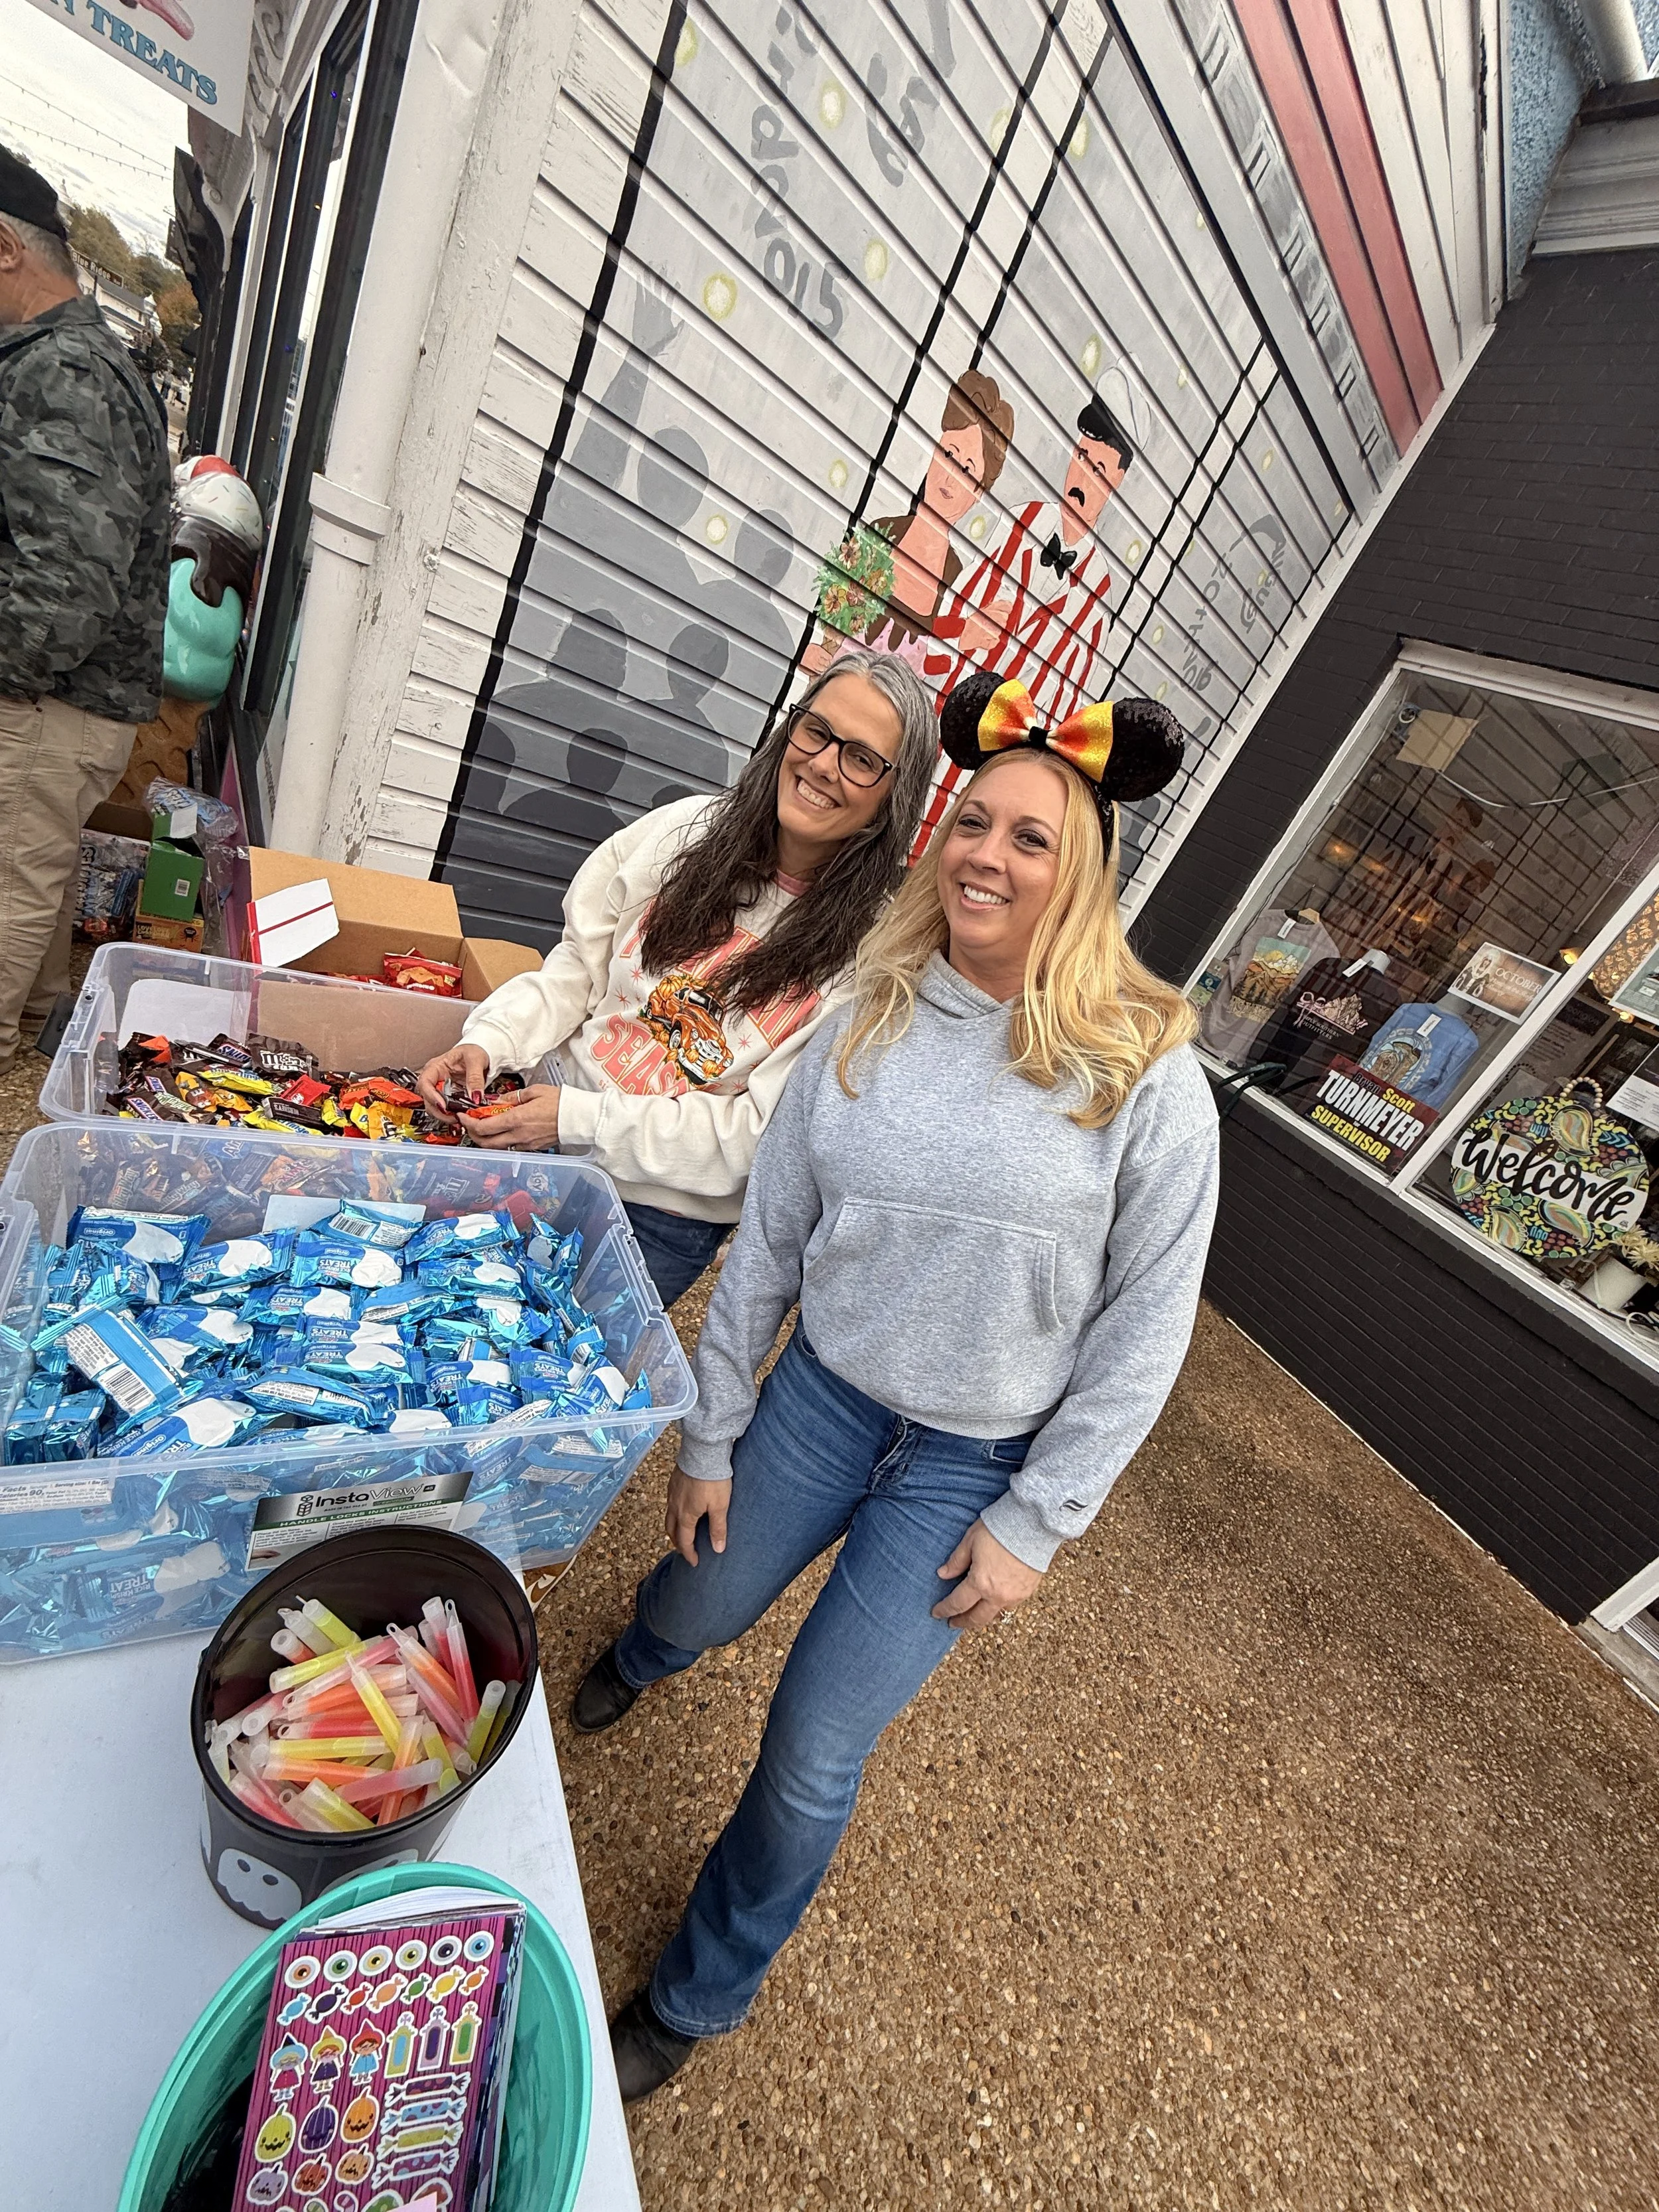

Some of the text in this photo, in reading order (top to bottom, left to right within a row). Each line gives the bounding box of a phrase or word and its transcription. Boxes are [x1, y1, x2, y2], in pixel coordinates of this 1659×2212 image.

[87, 0, 218, 106] TREATS
[1496, 968, 1542, 994] OCTOBER
[591, 1015, 690, 1096] SEAS
[1317, 1069, 1425, 1151] TURNMEYER
[1354, 1072, 1415, 1114] Bryan Scott
[1311, 1105, 1391, 1162] SUPERVISOR
[1462, 1128, 1635, 1222] Welcome
[319, 1259, 351, 1268] TREATS
[431, 1372, 463, 1388] TREATS
[534, 1363, 565, 1372] TREATS
[279, 1500, 442, 1527] HANDLE LOCKS INSTRUCTIONS
[110, 1574, 149, 1593] TREAT
